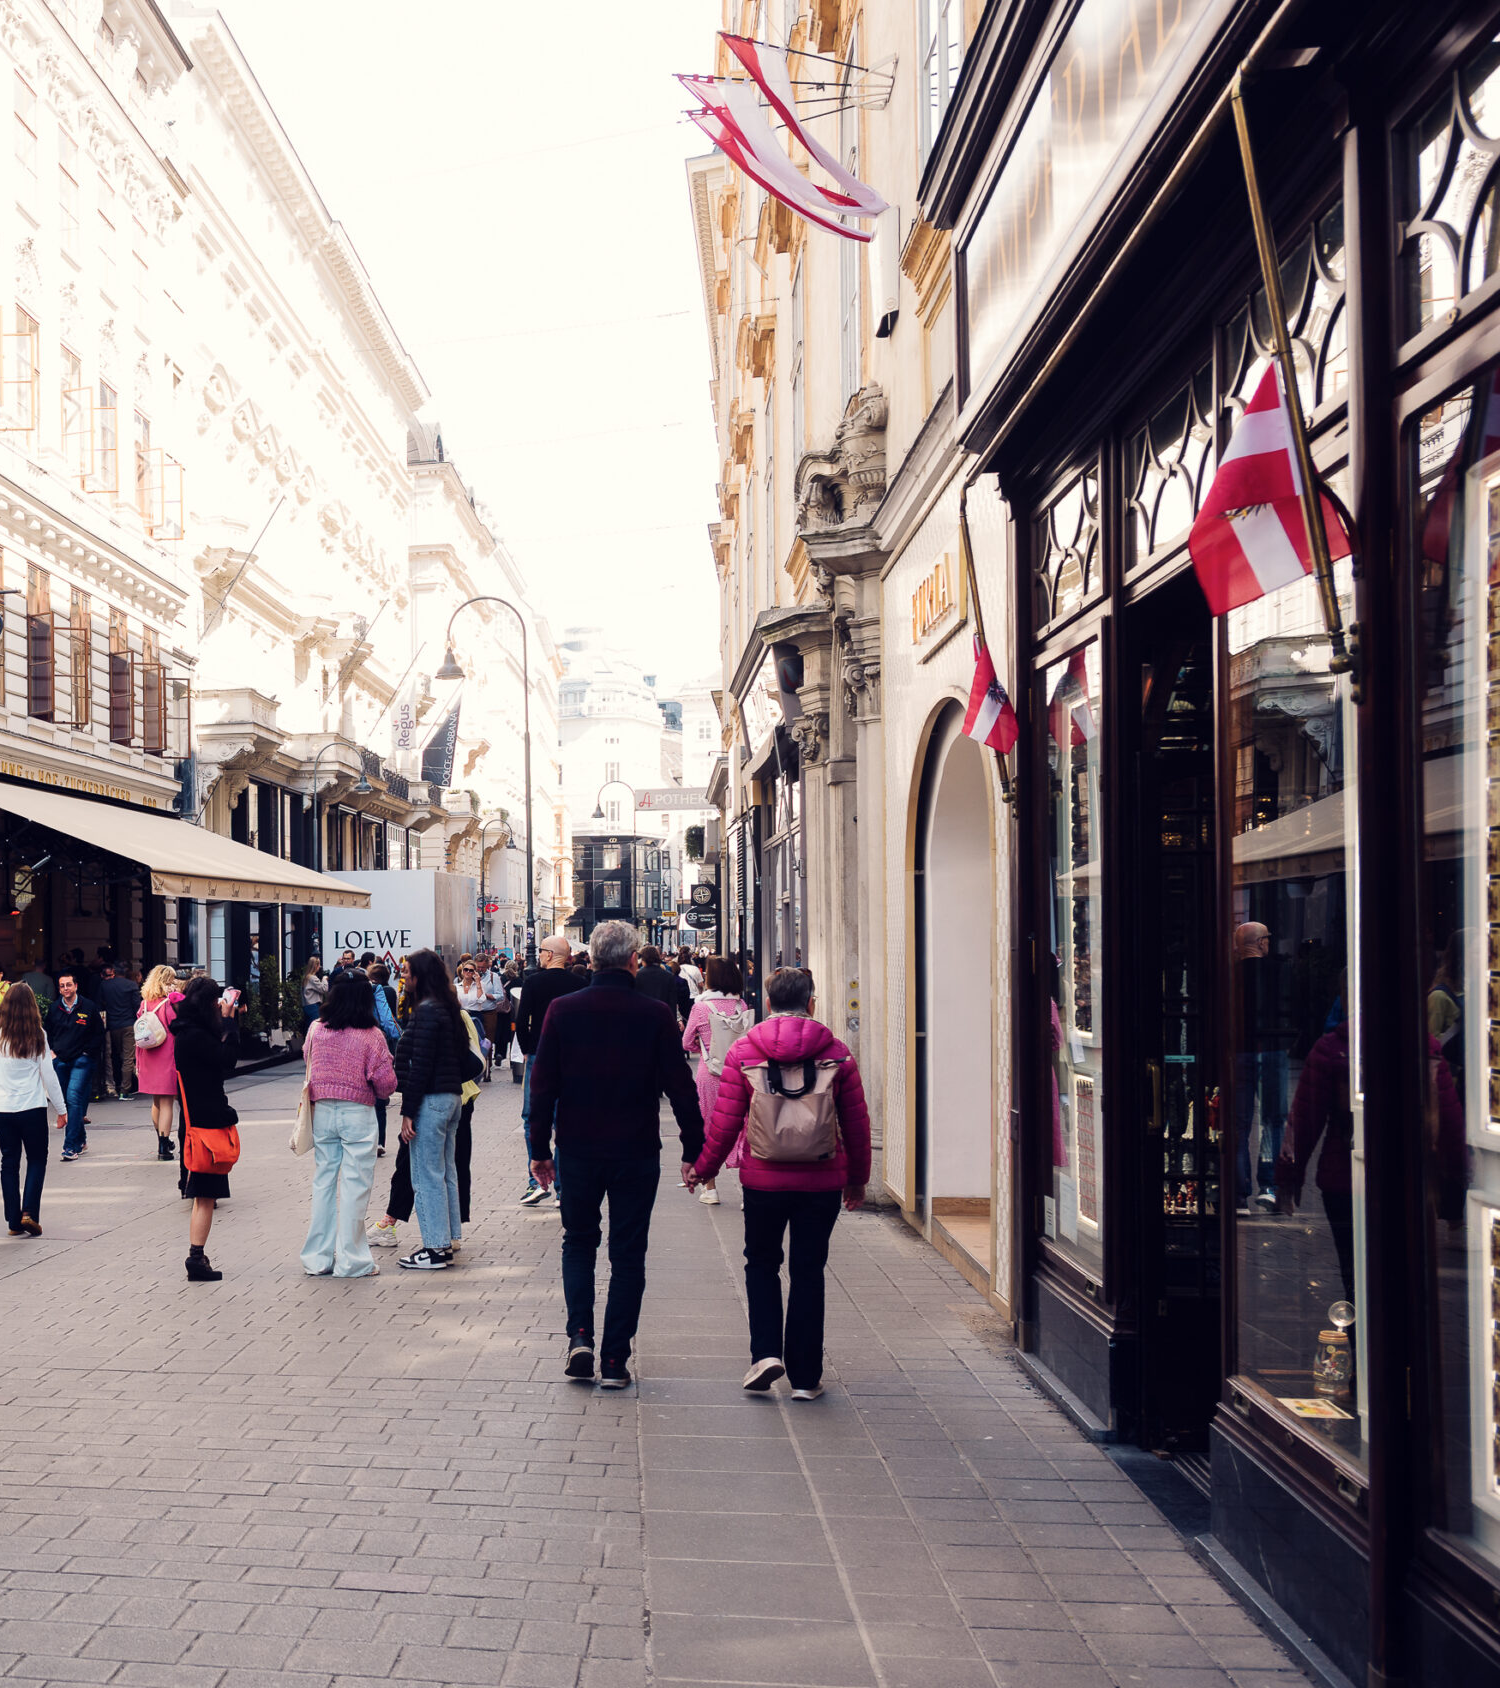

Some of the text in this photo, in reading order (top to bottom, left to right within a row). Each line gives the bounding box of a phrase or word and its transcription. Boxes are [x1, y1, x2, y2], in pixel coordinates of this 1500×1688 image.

[397, 703, 414, 747] Regus
[445, 711, 458, 755] GABBANA
[639, 791, 708, 807] APOTHEK
[334, 929, 411, 950] LOEWE
